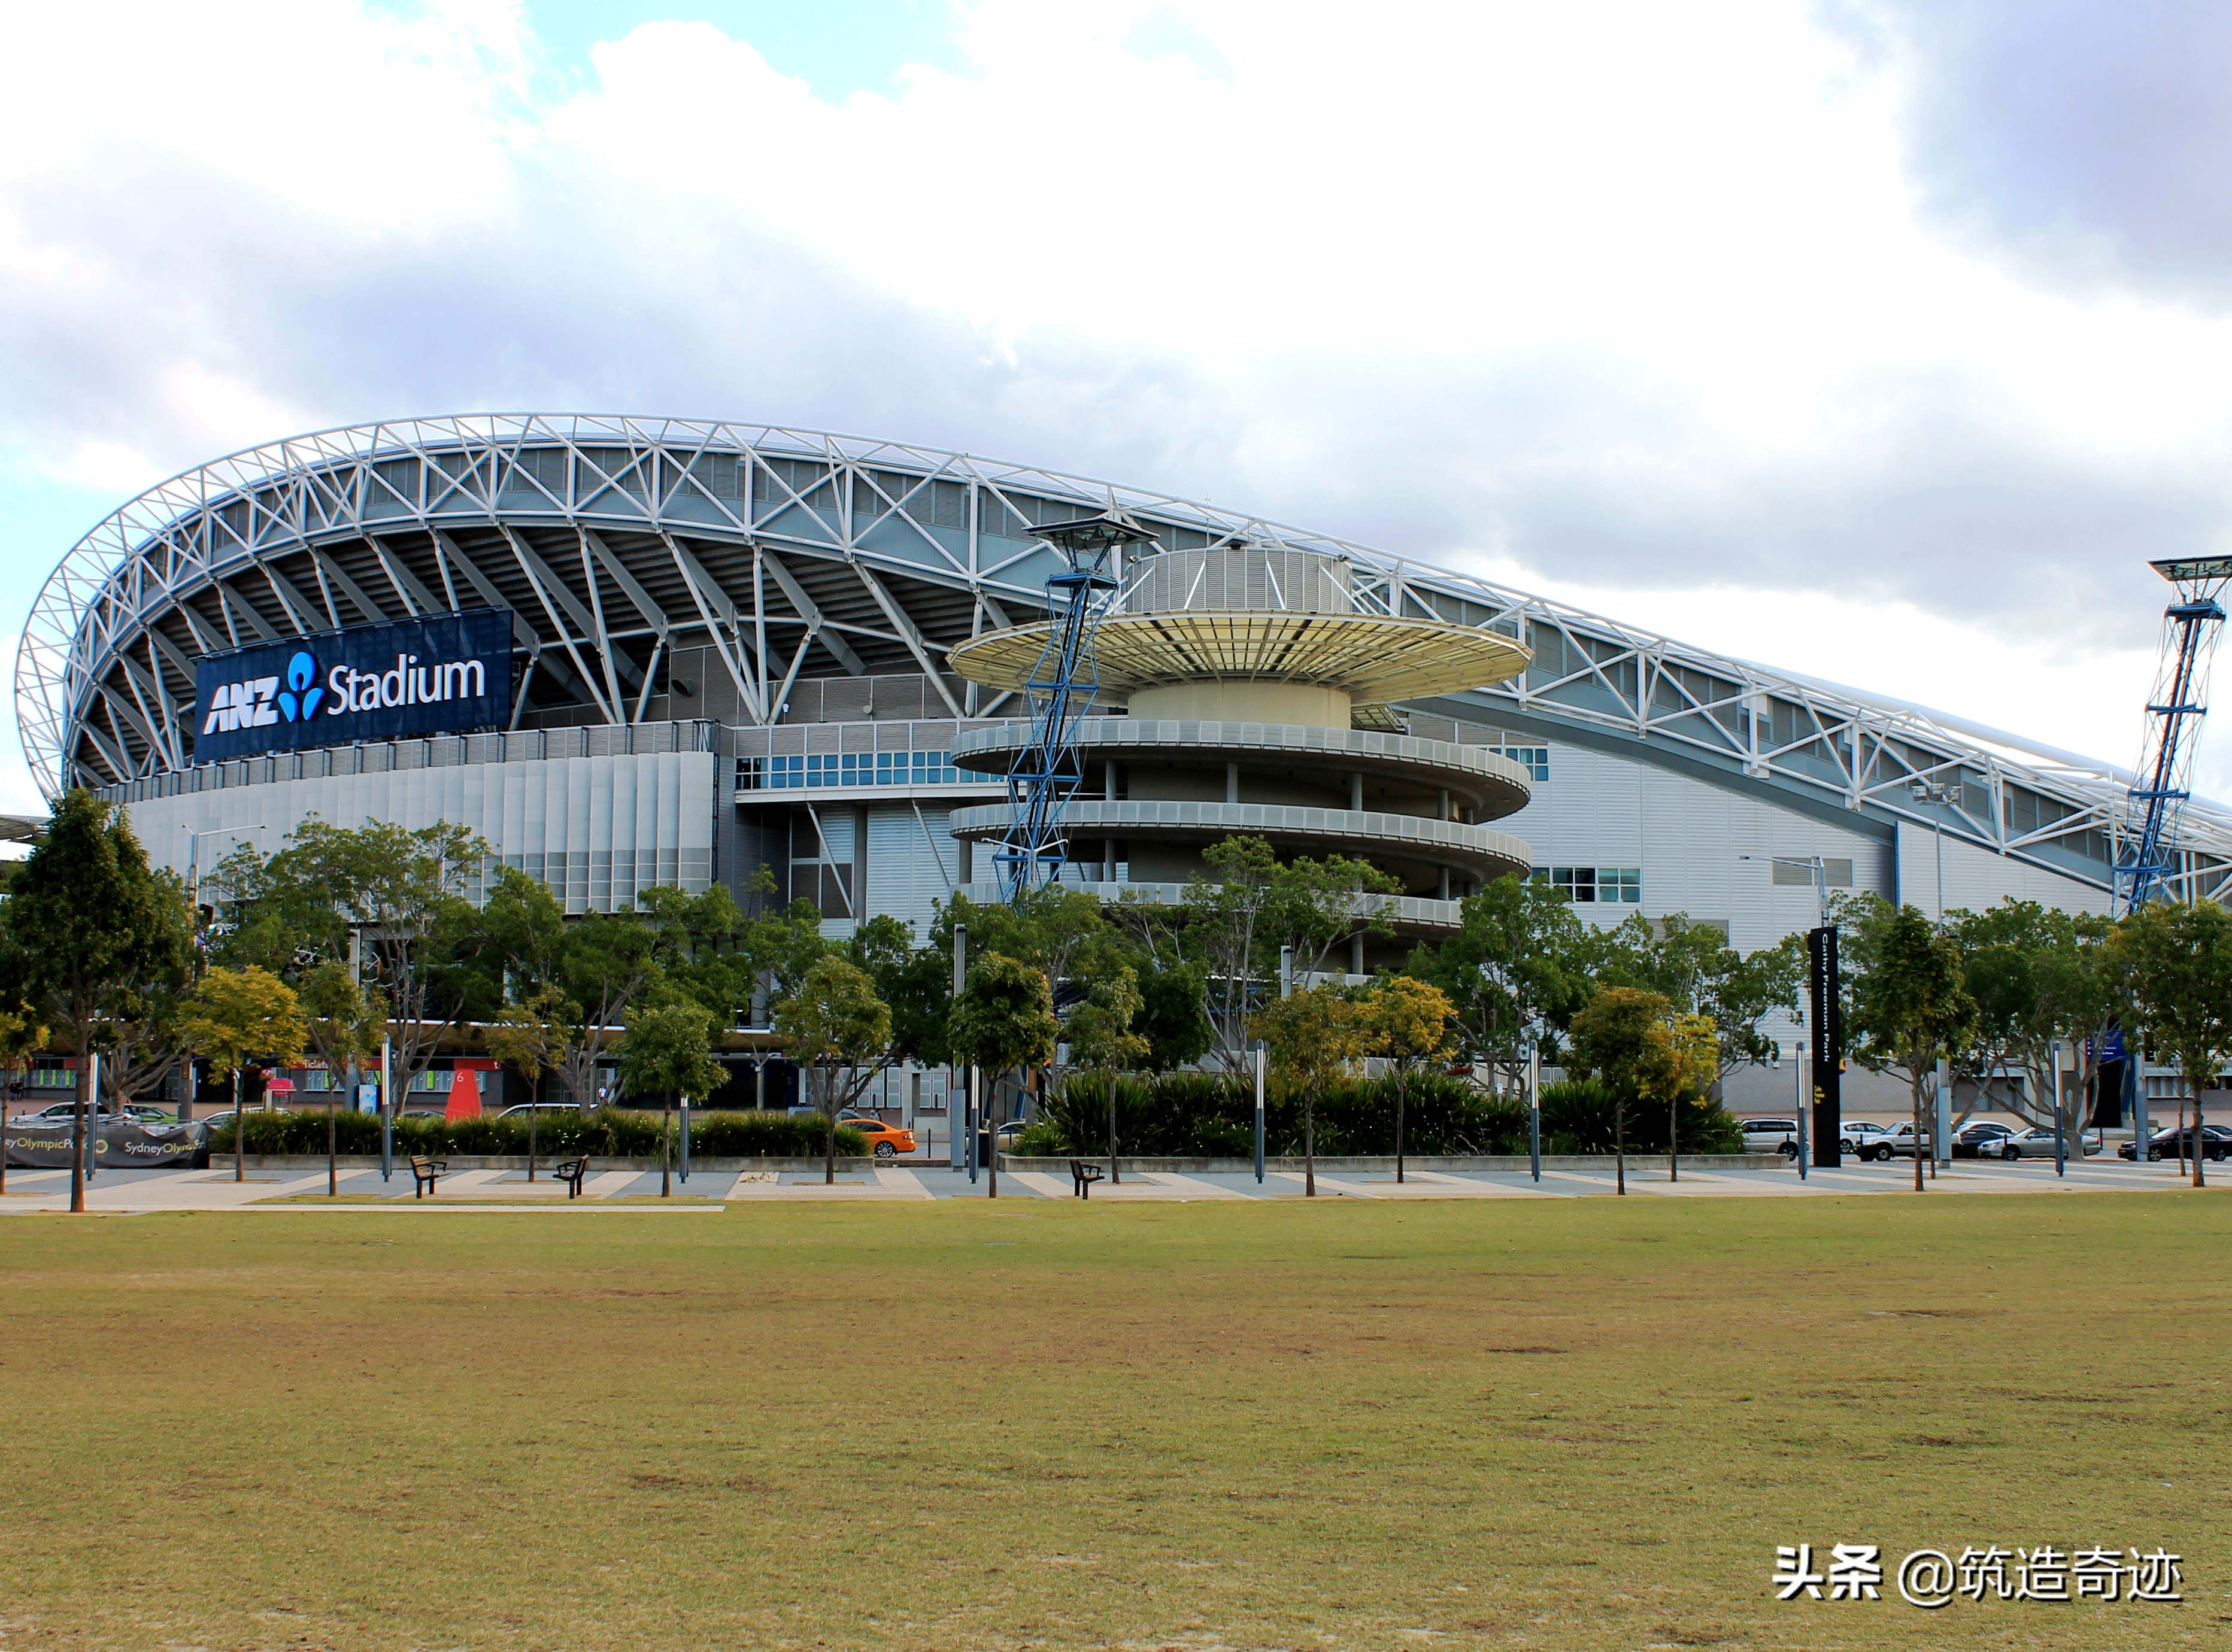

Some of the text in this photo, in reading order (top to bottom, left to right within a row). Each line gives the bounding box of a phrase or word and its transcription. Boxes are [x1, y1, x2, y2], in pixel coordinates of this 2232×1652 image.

[204, 653, 485, 735] ANZ Stadium
[457, 1072, 464, 1082] 6
